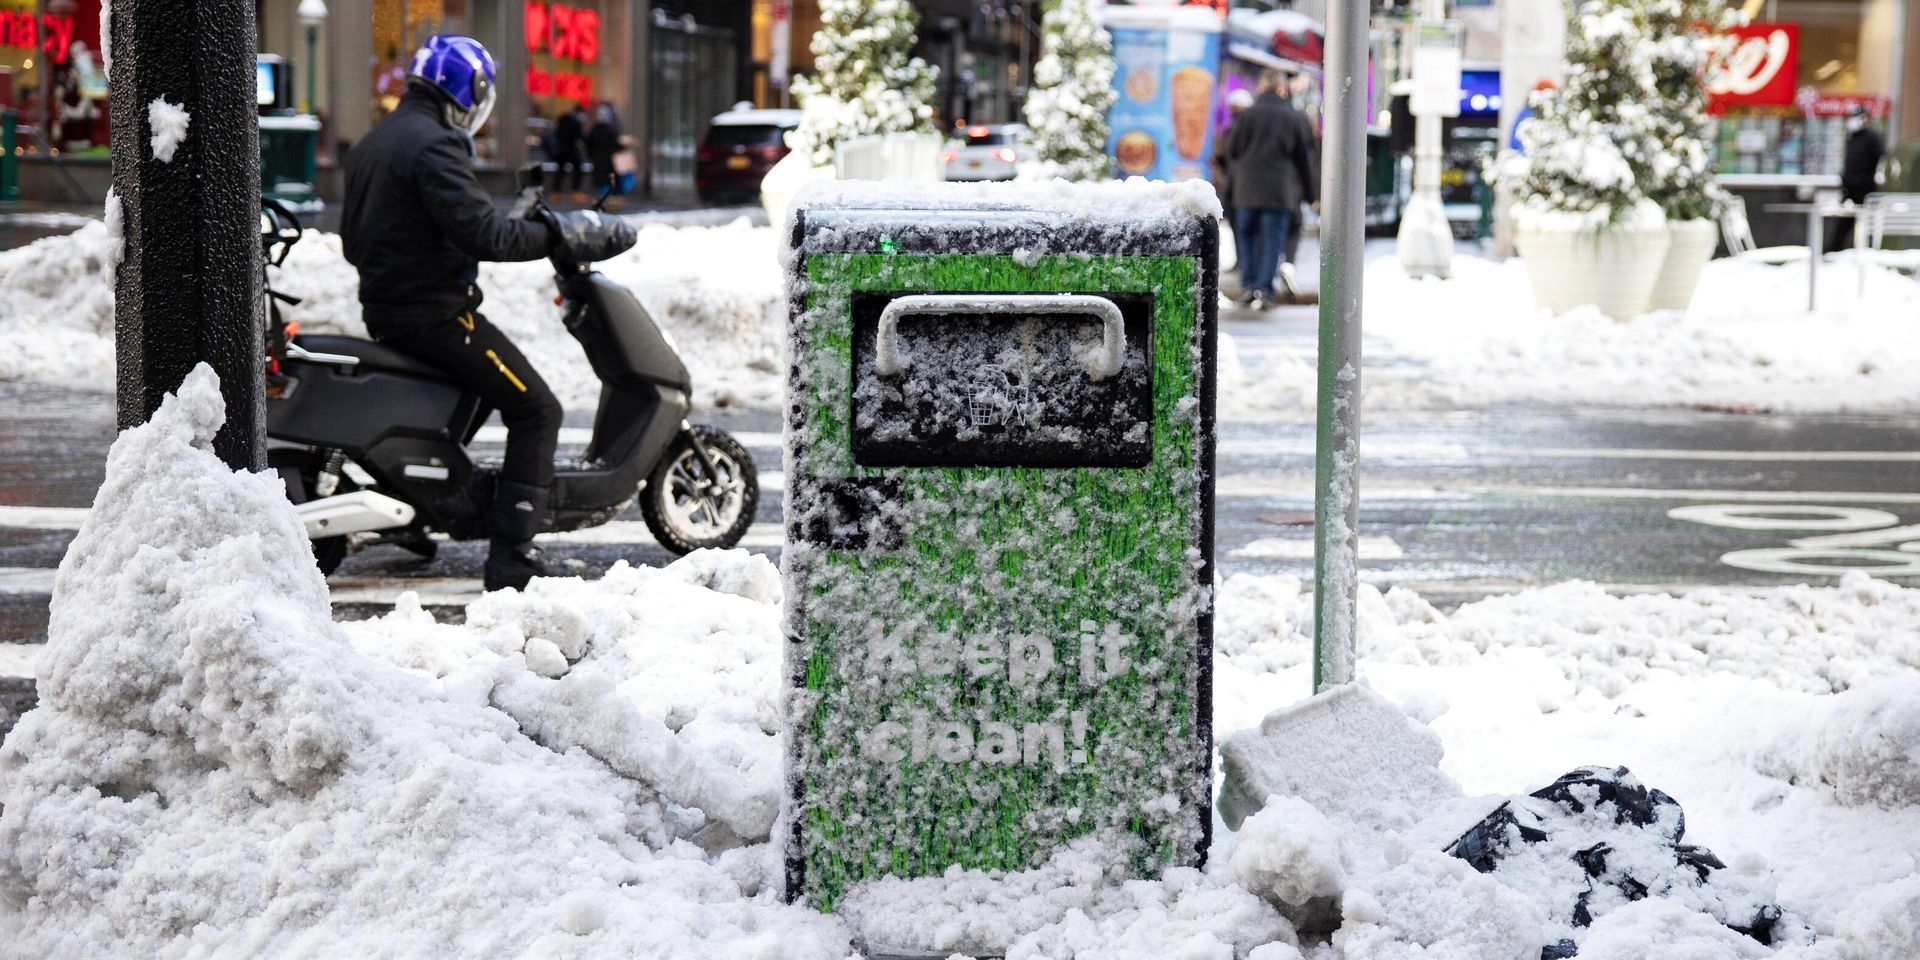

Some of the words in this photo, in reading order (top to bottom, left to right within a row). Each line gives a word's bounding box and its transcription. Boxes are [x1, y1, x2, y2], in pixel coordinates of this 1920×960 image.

[866, 618, 1055, 690] Keep
[1079, 619, 1137, 679] it
[867, 708, 1088, 764] clean!
